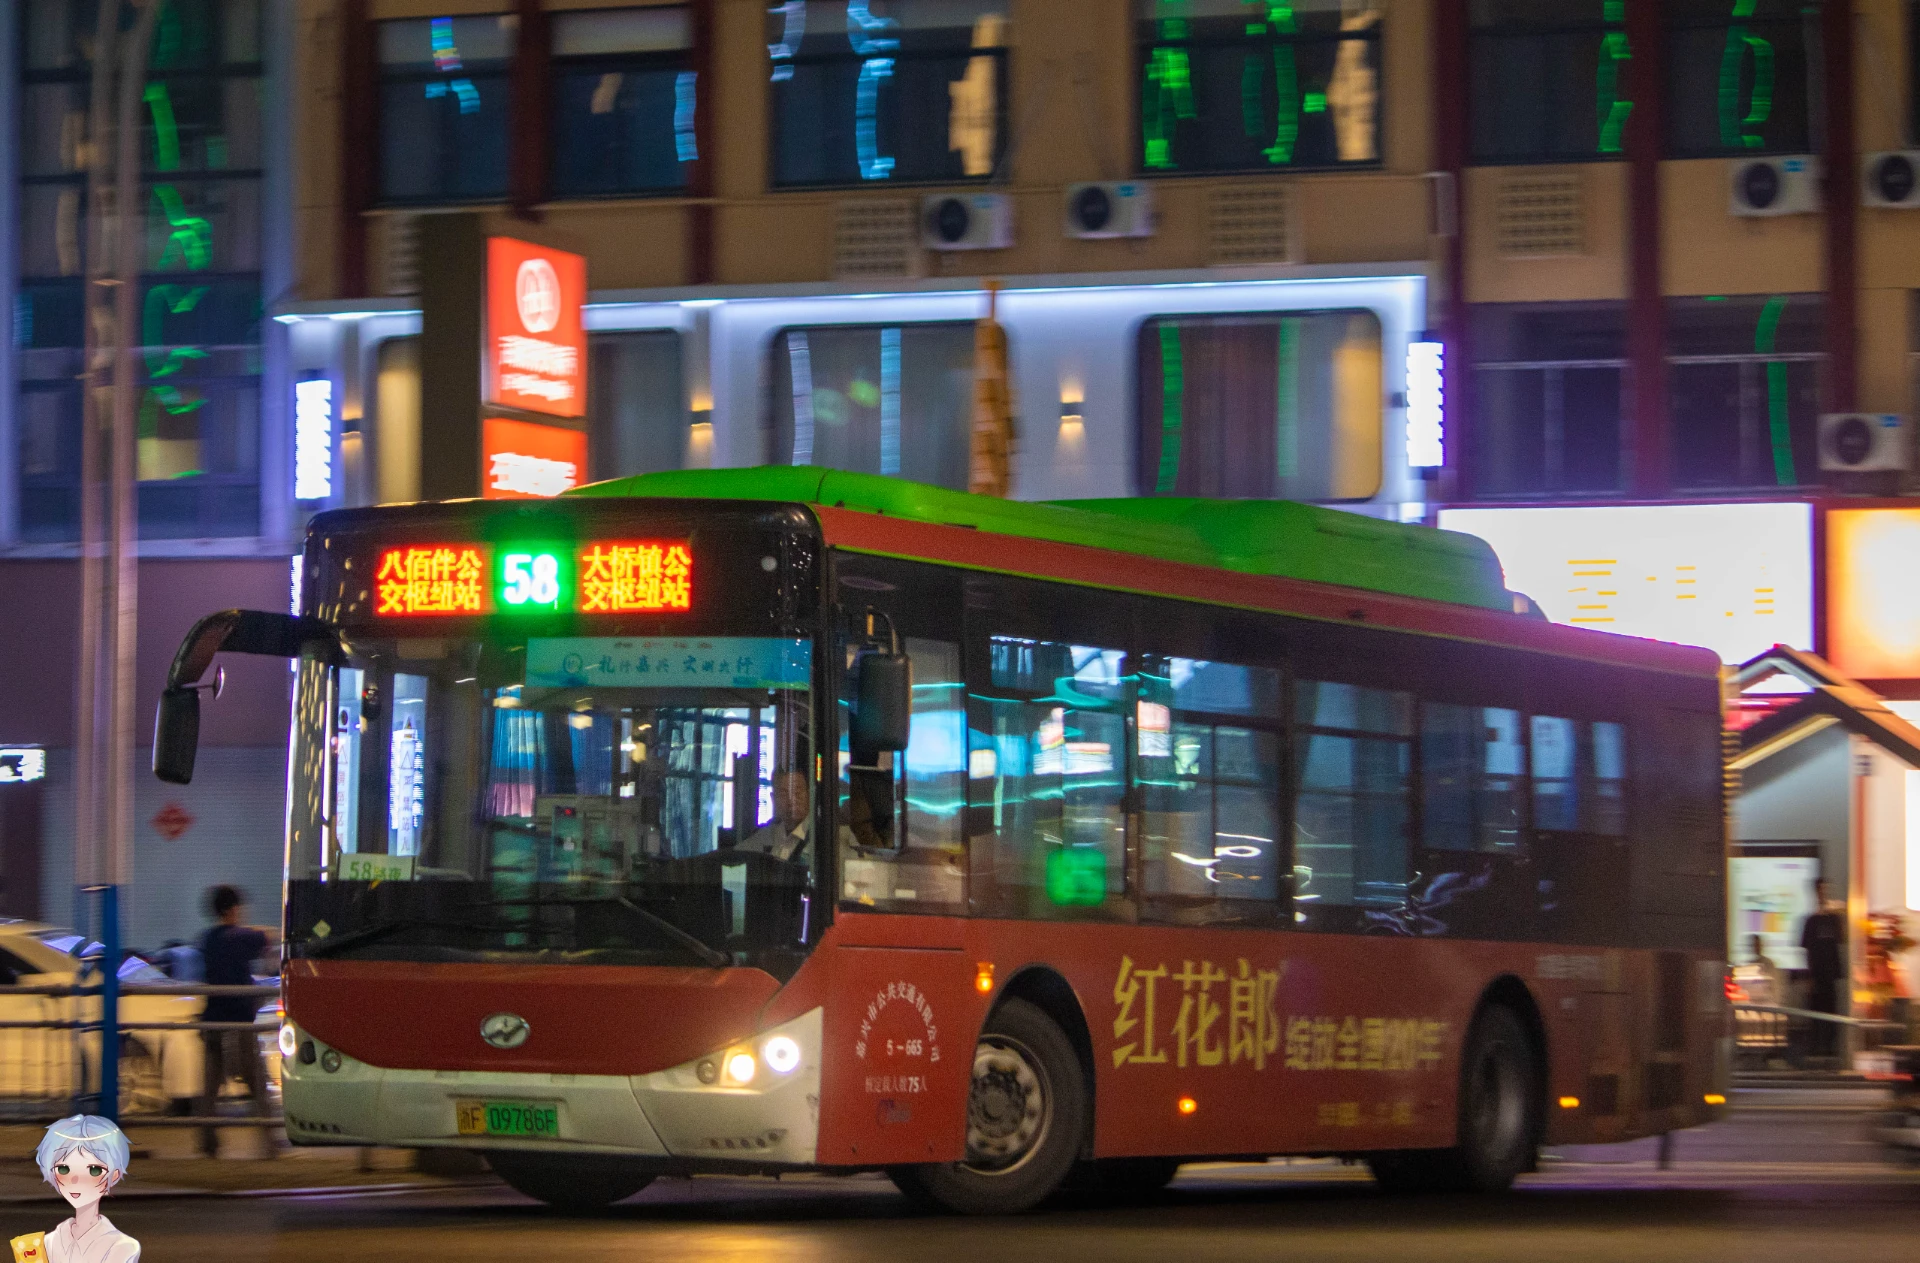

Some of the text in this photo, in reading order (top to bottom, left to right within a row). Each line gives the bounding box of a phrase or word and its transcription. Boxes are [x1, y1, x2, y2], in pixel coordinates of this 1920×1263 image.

[378, 549, 482, 580] 八佰伴公
[503, 553, 559, 605] 58
[583, 546, 691, 579] 大桥镇公
[378, 580, 482, 612] 交枢纽站
[583, 577, 691, 611] 交枢纽站
[1112, 955, 1280, 1071] 红花郎
